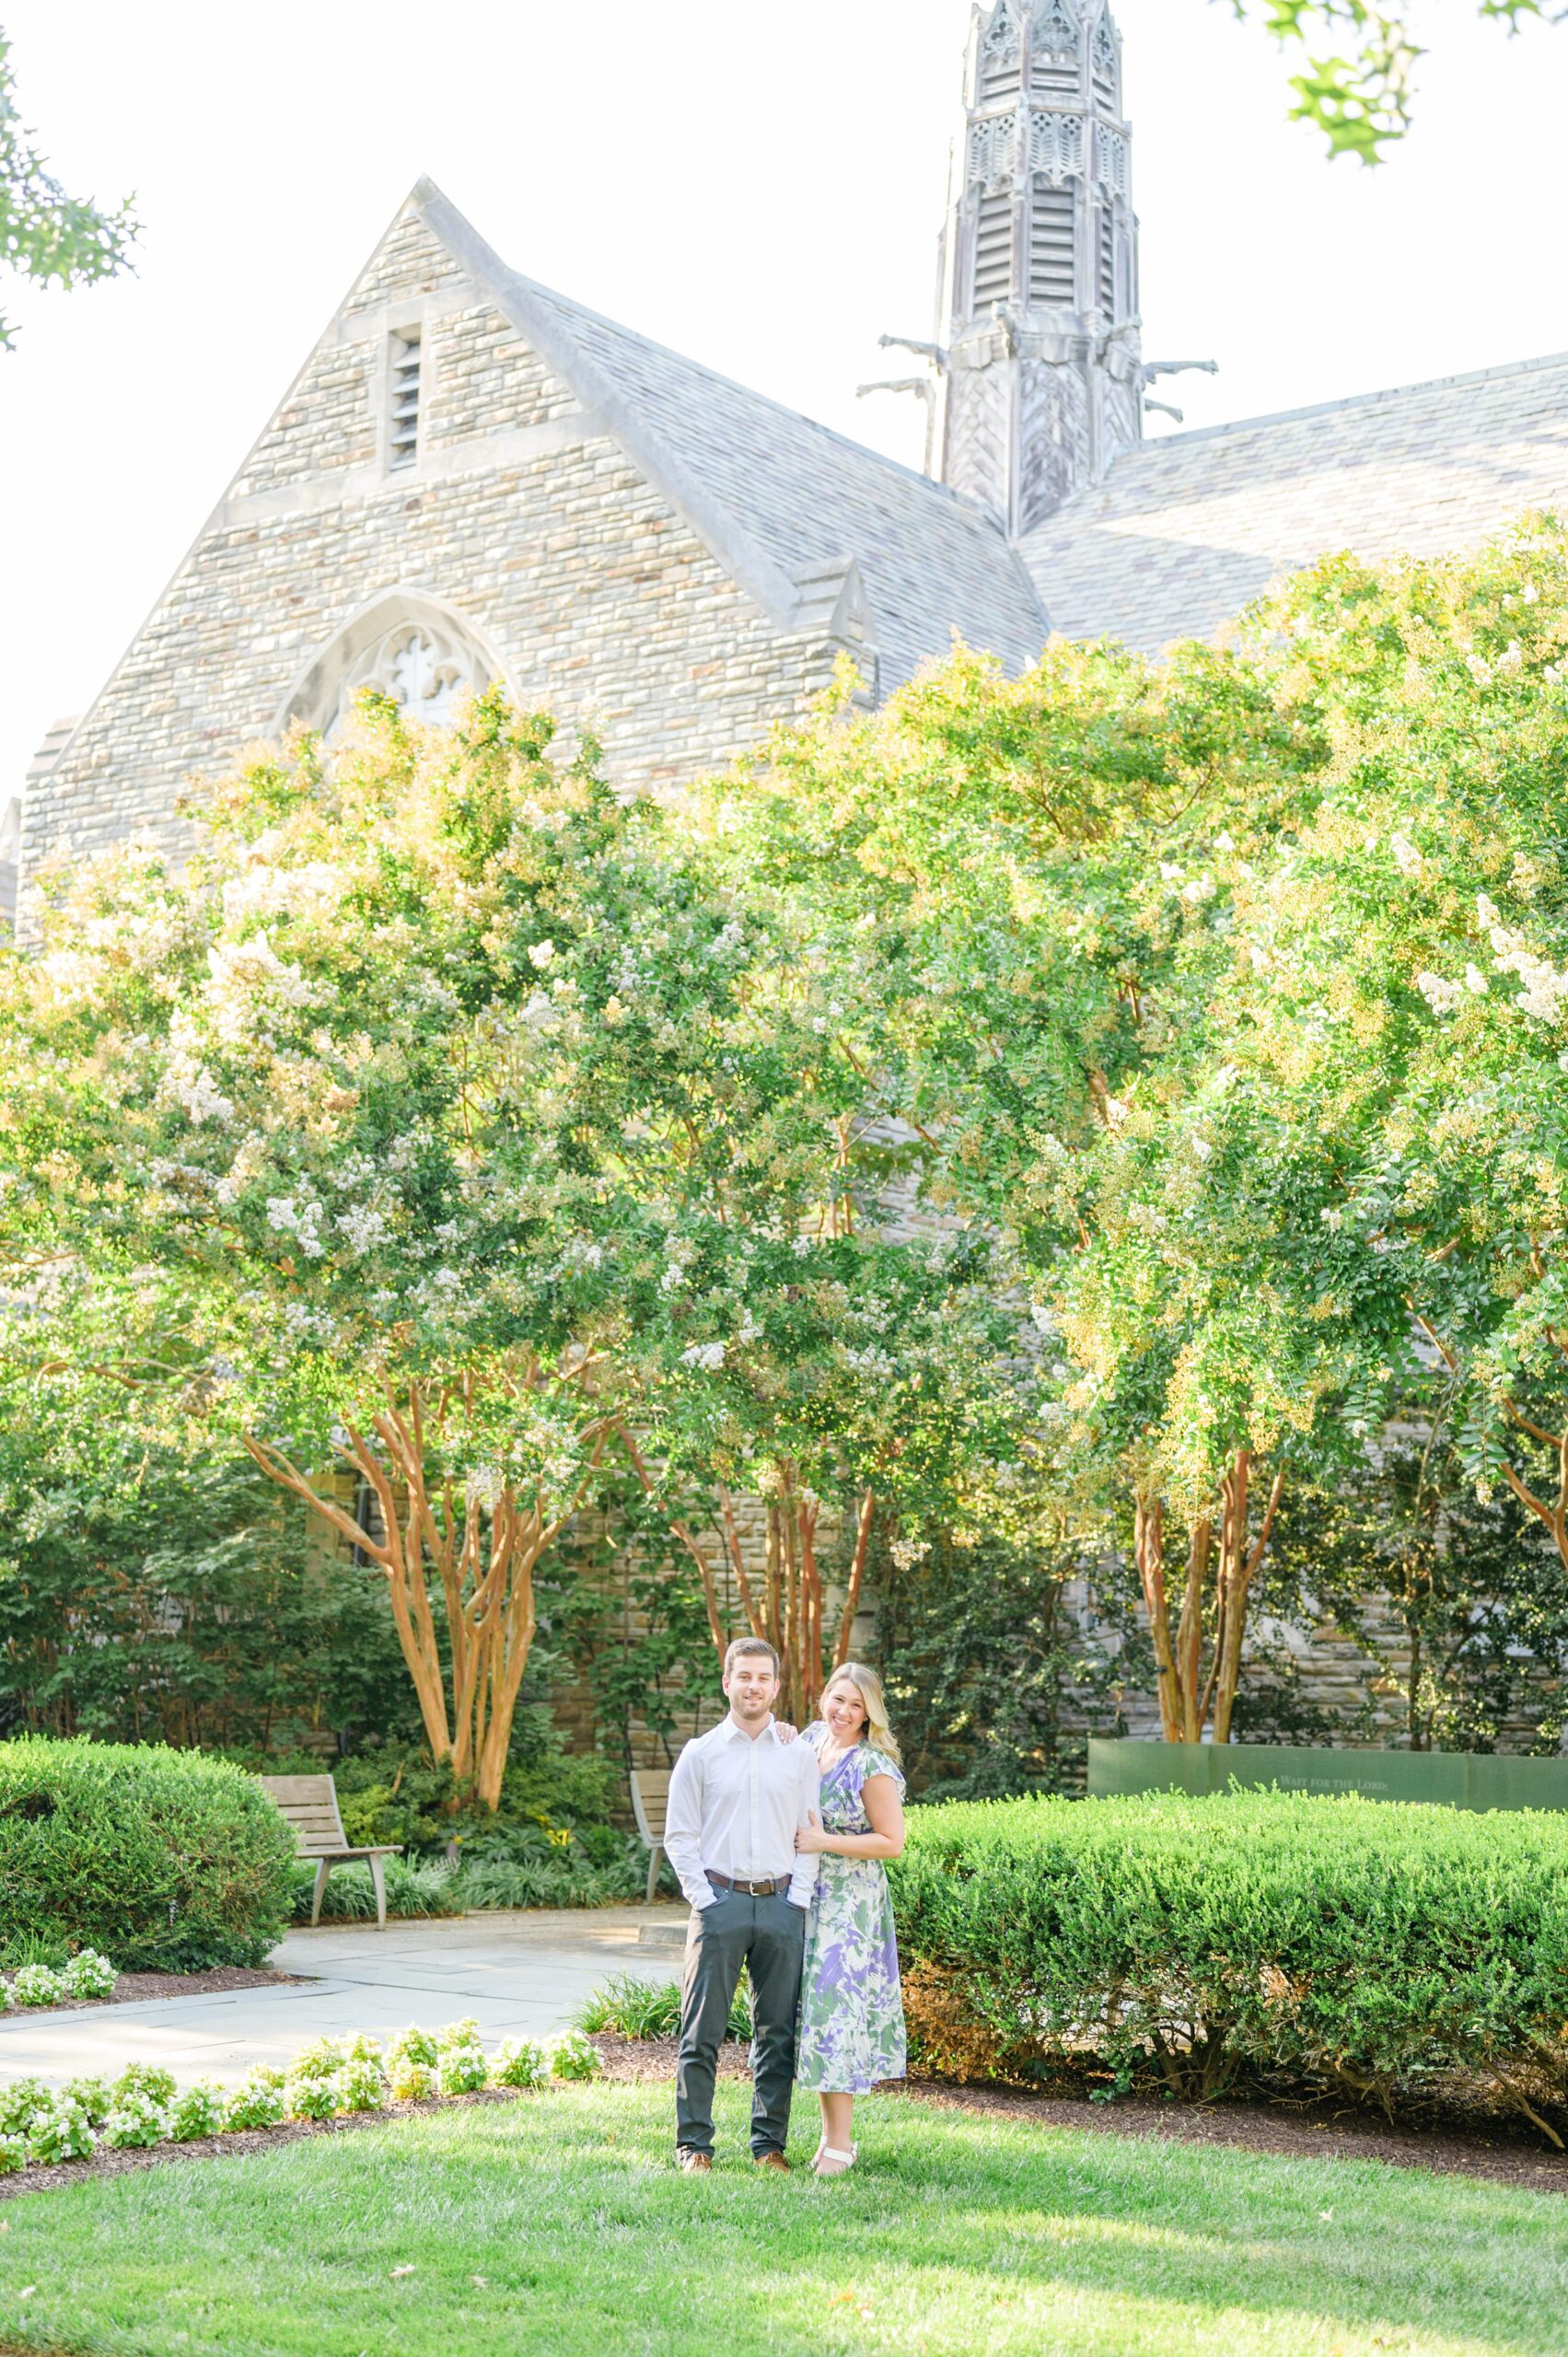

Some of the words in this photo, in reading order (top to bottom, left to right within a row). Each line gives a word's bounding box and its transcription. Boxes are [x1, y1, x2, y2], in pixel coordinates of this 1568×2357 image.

[1281, 1775, 1307, 1786] WAIT
[1311, 1778, 1330, 1788] FOR
[1333, 1780, 1353, 1789] THE
